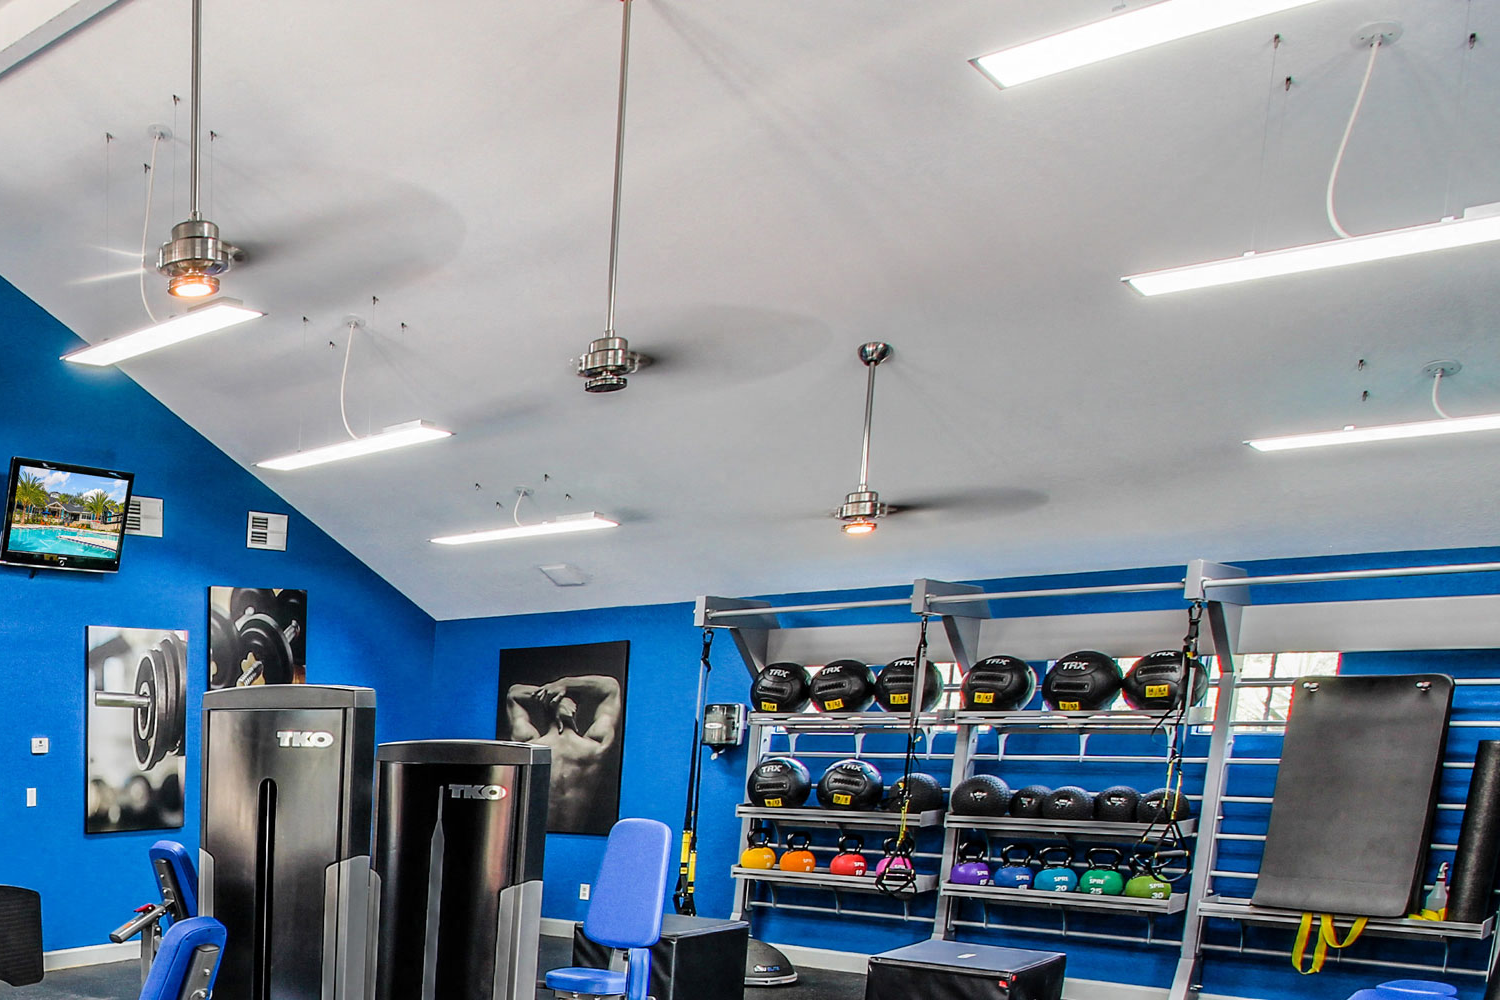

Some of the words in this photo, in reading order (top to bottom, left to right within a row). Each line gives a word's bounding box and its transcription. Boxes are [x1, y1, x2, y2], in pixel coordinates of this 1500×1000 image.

[893, 659, 916, 667] TRX
[985, 658, 1011, 666] TRX
[1061, 661, 1089, 671] TRX
[768, 668, 791, 678] TRX
[820, 665, 843, 676] TRX
[276, 731, 334, 747] TKO
[761, 764, 783, 773] TRX
[841, 763, 863, 772] TRX
[449, 784, 508, 801] TKO
[1055, 884, 1068, 892] 20
[1090, 887, 1103, 895] 25
